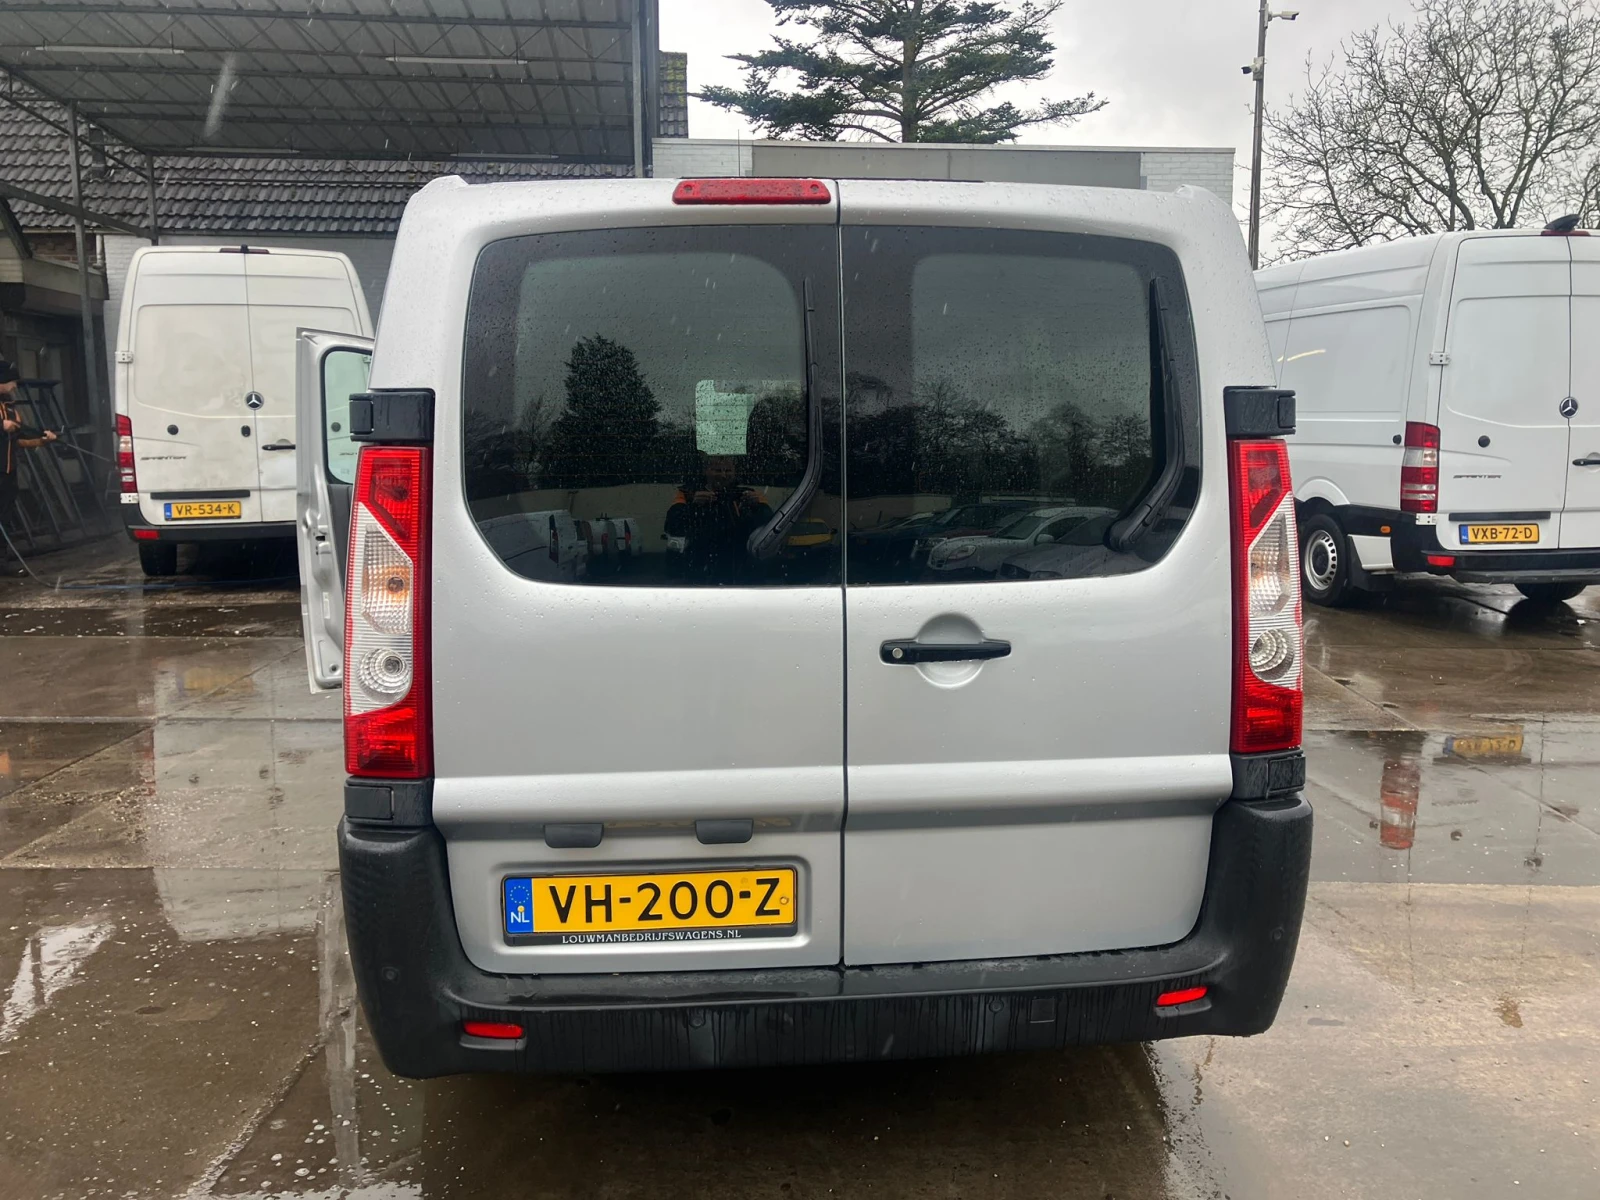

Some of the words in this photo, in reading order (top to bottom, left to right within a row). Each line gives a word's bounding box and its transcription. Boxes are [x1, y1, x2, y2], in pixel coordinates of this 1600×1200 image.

[175, 503, 235, 516] VR-534-K
[1472, 527, 1533, 540] VXB-72-D
[510, 911, 530, 923] NL
[548, 877, 780, 924] VH-200-Z
[562, 929, 742, 944] LOUWMANBEDRIJFSWAGENS.NL
